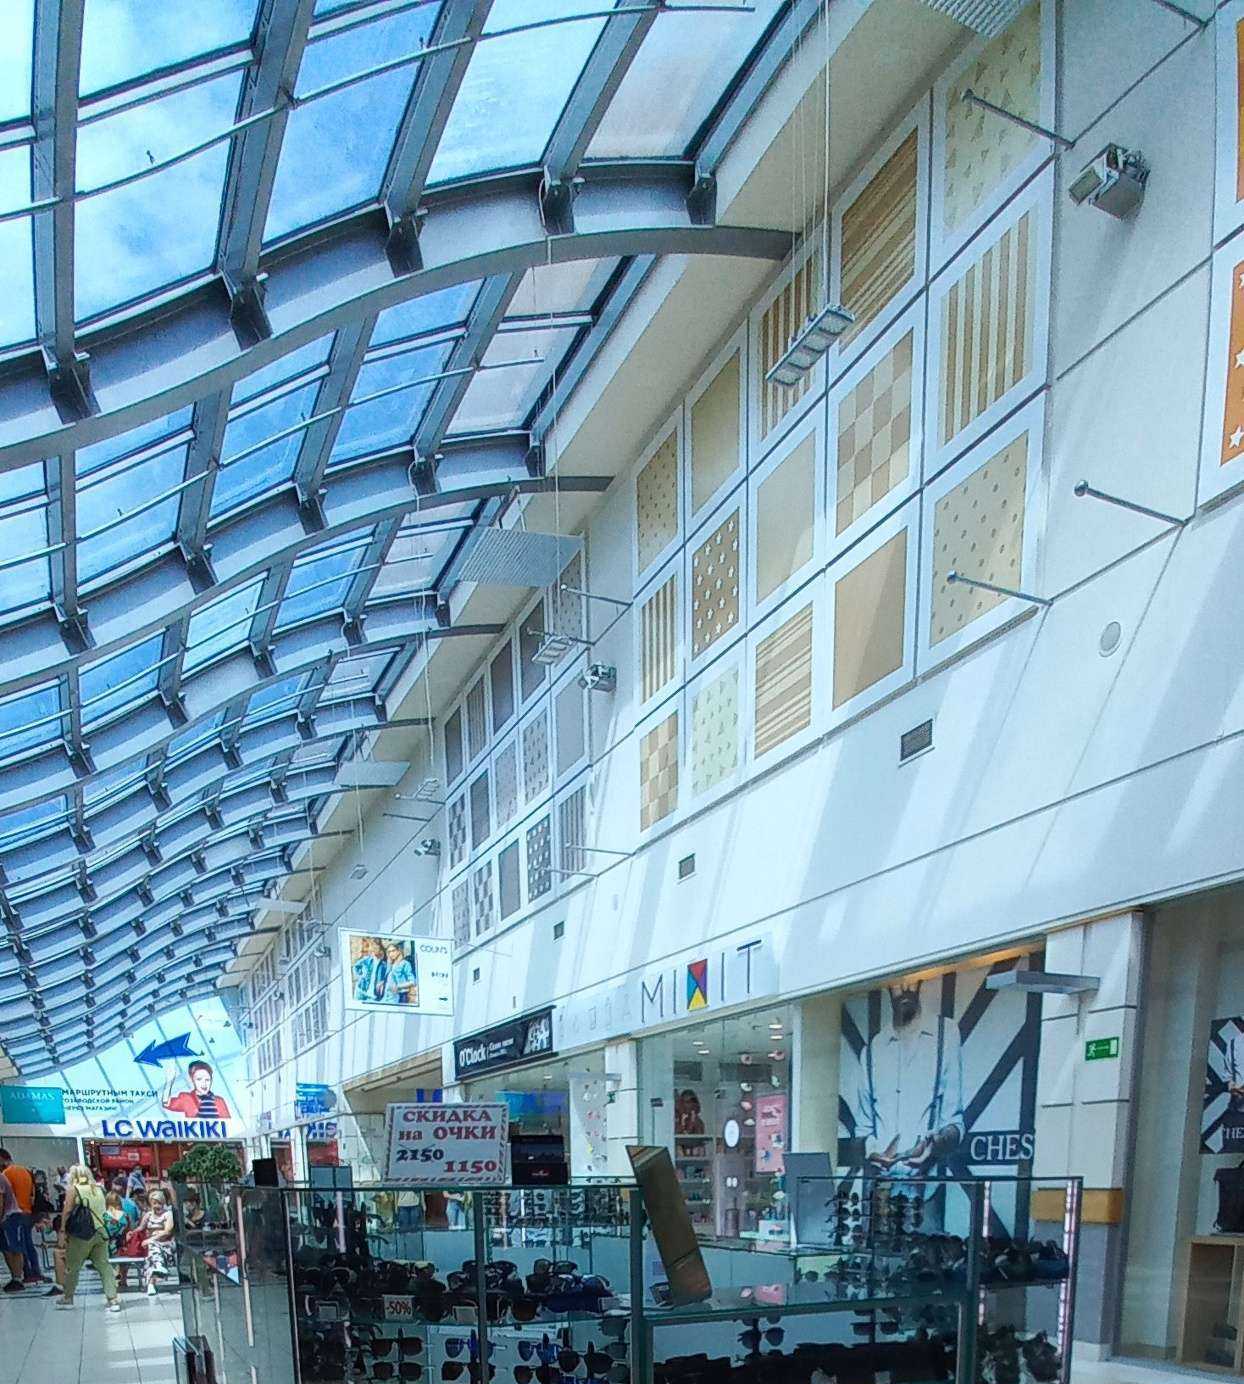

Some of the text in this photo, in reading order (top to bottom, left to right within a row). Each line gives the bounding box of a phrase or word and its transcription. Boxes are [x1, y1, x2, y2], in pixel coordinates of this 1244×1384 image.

[402, 1110, 492, 1123] СКИДКА
[102, 1119, 133, 1137] LC
[399, 1126, 496, 1141] на ОЧКИ
[396, 1149, 444, 1163] 2150
[444, 1160, 497, 1173] 1150
